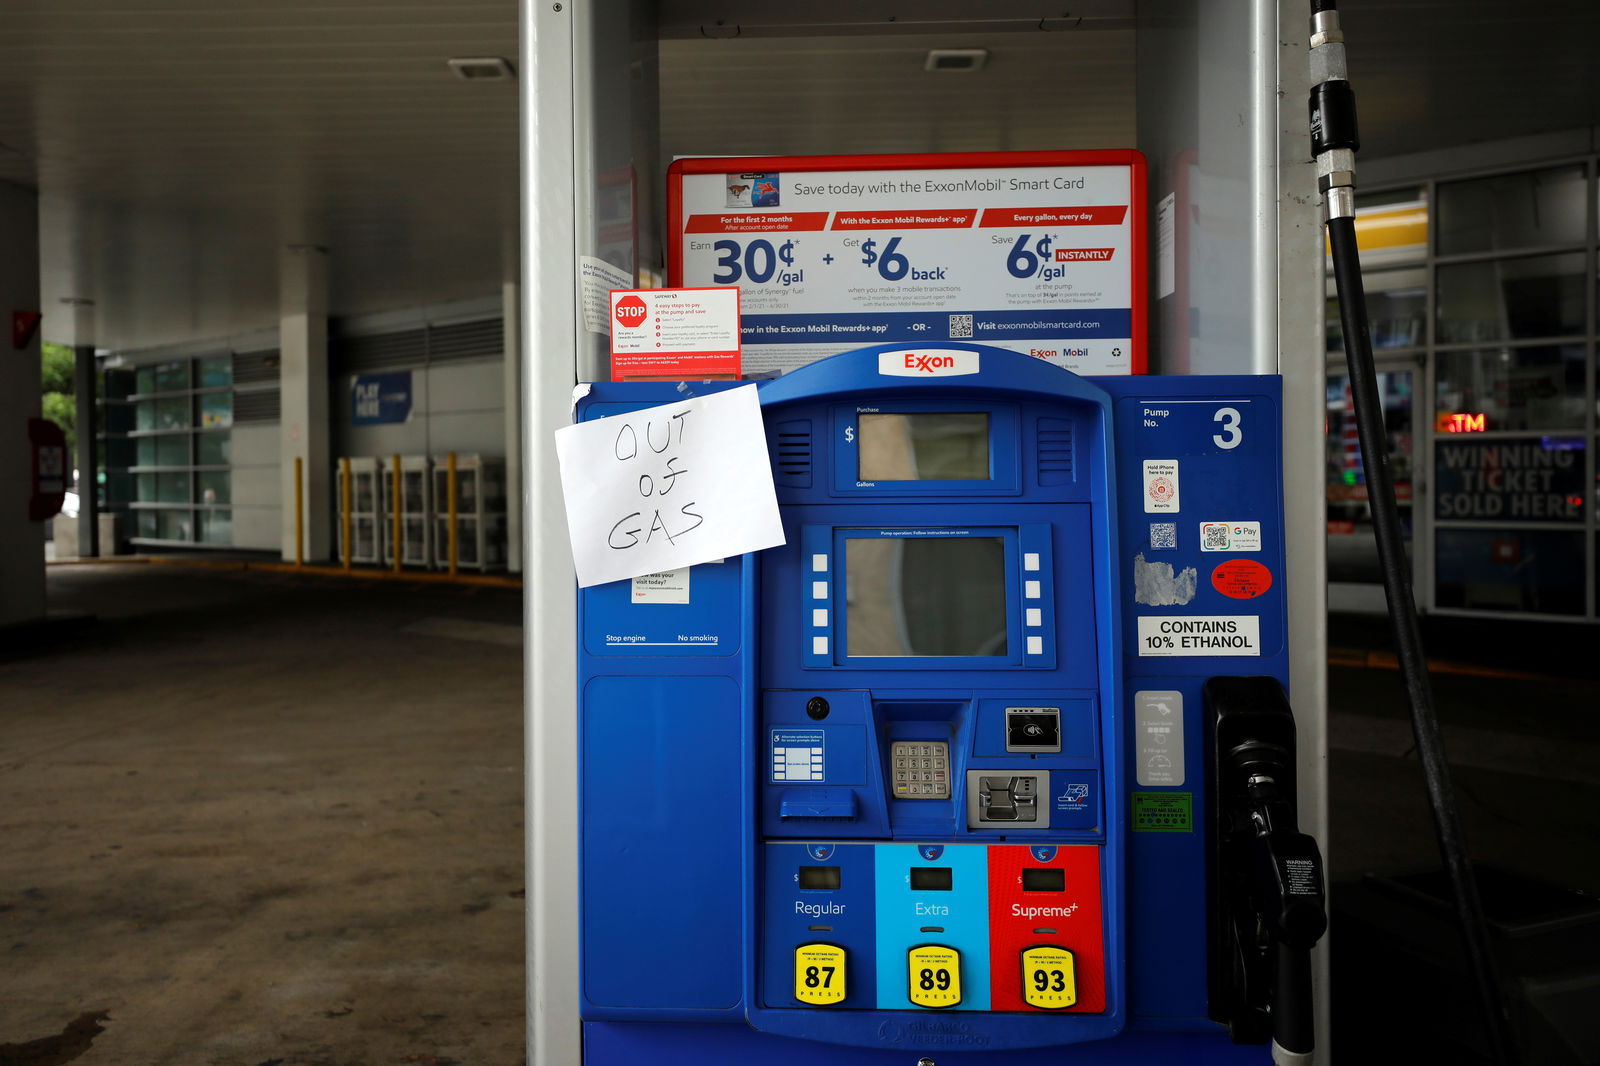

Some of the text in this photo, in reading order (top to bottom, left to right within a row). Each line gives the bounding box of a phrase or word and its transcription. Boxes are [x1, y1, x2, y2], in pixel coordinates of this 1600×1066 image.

[794, 183, 824, 195] Save
[829, 181, 864, 196] today
[868, 182, 898, 194] with
[900, 180, 921, 192] the
[1010, 178, 1049, 190] Smart
[1054, 177, 1084, 190] Card
[1035, 214, 1058, 222] gallon,
[690, 242, 710, 250] Earn
[992, 235, 1013, 244] Save
[843, 237, 909, 281] Get $6
[1058, 251, 1109, 260] INSTANTLY
[776, 269, 803, 286] /gal
[1038, 265, 1065, 281] /gal
[617, 306, 645, 317] STOP
[998, 320, 1100, 329] exxonmobilsmartcard.com
[1030, 349, 1057, 359] Exxon
[905, 354, 954, 372] Exxon
[615, 410, 691, 461] OUT
[845, 426, 854, 443] $
[1144, 407, 1242, 449] Pump 3
[1444, 446, 1574, 468] WINNING
[1462, 470, 1554, 491] TICKET
[1439, 494, 1580, 516] SOLD HERE
[608, 502, 703, 549] GAS
[1243, 528, 1257, 536] Pay
[1160, 621, 1237, 633] CONTAINS
[1146, 636, 1252, 649] 10% ETHANOL
[793, 874, 799, 882] $
[795, 901, 846, 918] Regular
[915, 902, 949, 916] Extra
[1012, 903, 1078, 919] Supreme+
[805, 966, 835, 988] 87
[919, 968, 951, 991] 89
[1034, 970, 1065, 992] 93
